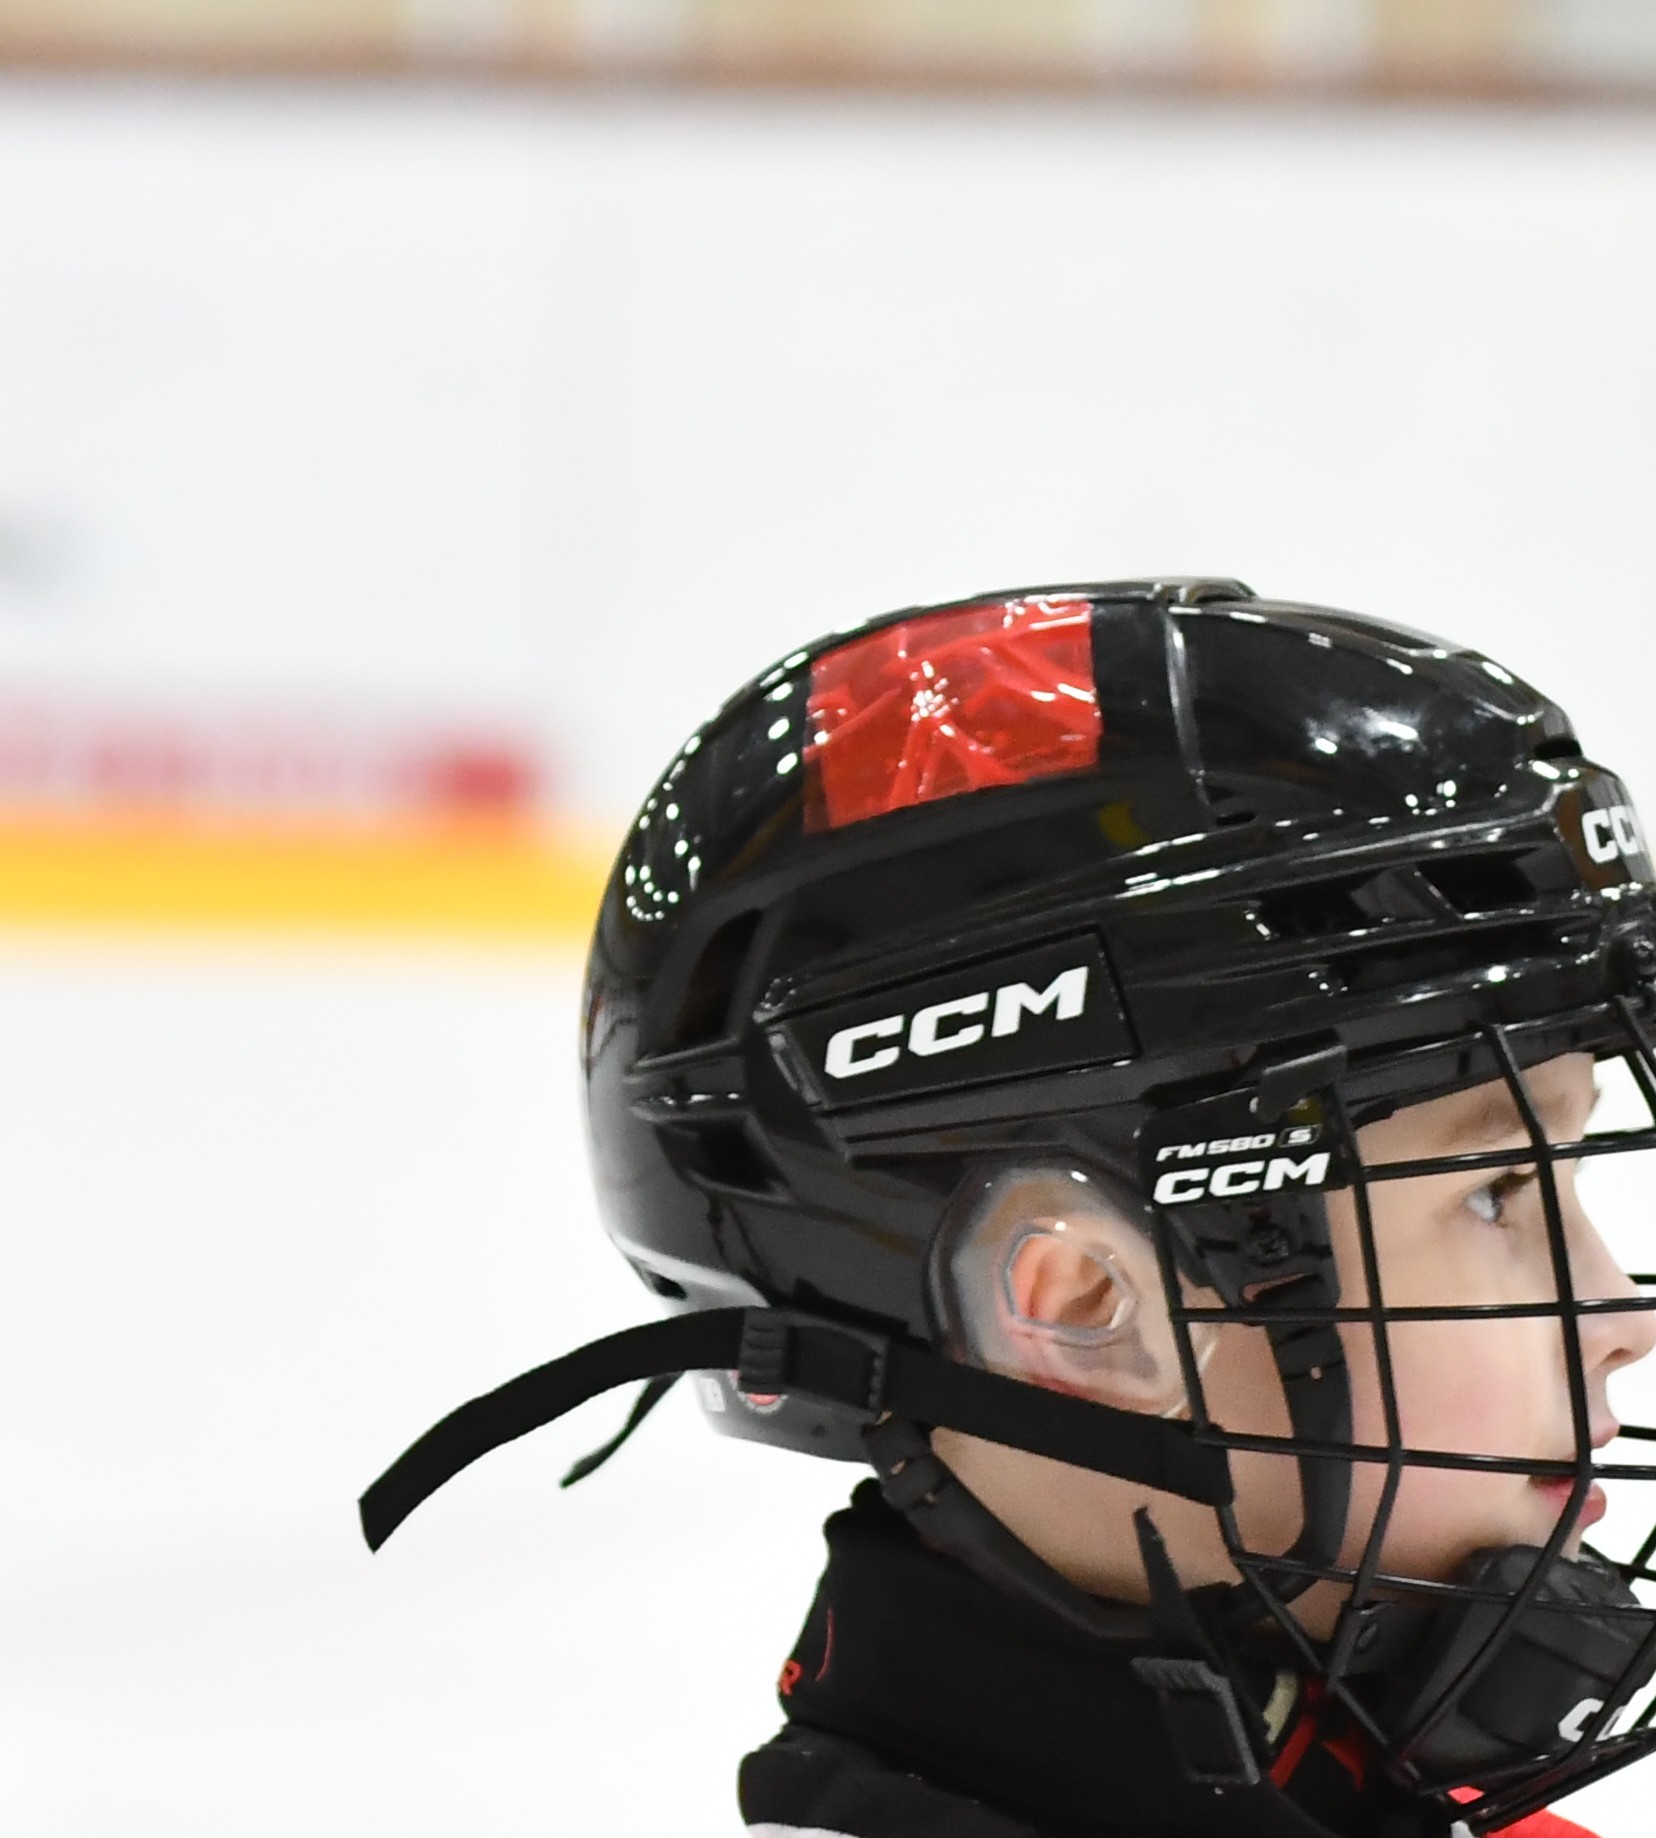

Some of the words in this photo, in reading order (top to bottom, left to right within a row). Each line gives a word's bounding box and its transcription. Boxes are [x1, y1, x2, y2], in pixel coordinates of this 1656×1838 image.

[1582, 805, 1648, 864] CC
[824, 966, 1089, 1079] CCM
[1156, 1133, 1276, 1162] FM580
[1153, 1152, 1331, 1204] CCM
